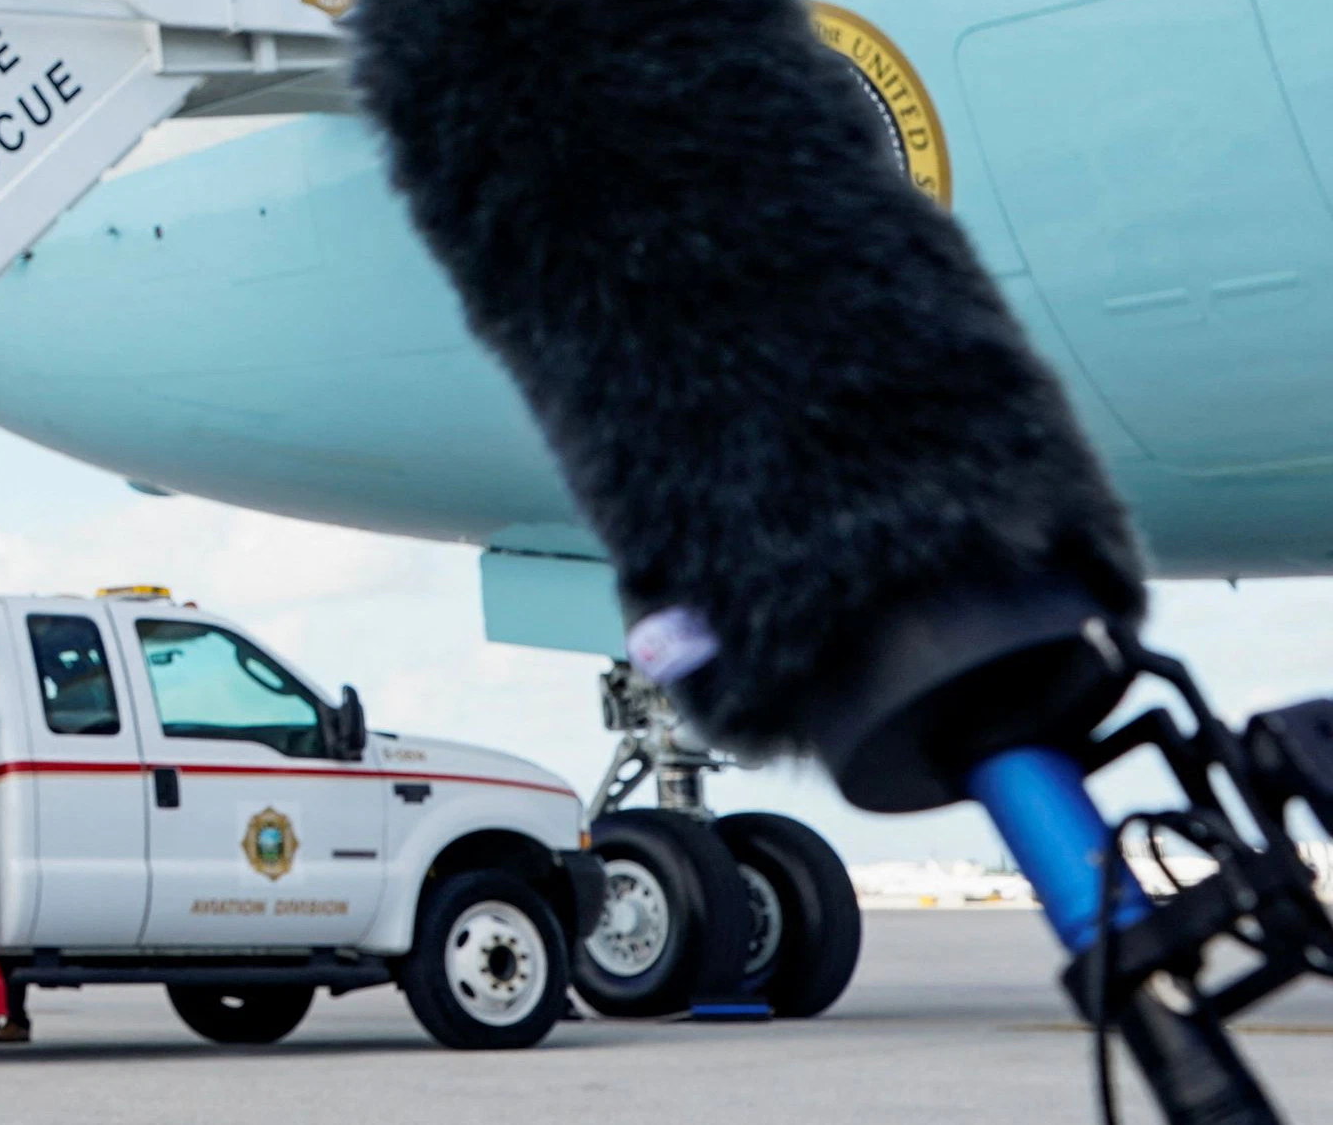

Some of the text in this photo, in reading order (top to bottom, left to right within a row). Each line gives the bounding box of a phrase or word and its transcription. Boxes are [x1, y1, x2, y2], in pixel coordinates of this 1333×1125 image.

[852, 36, 929, 152] UNITED
[190, 898, 349, 916] AVIATION DIVISION
